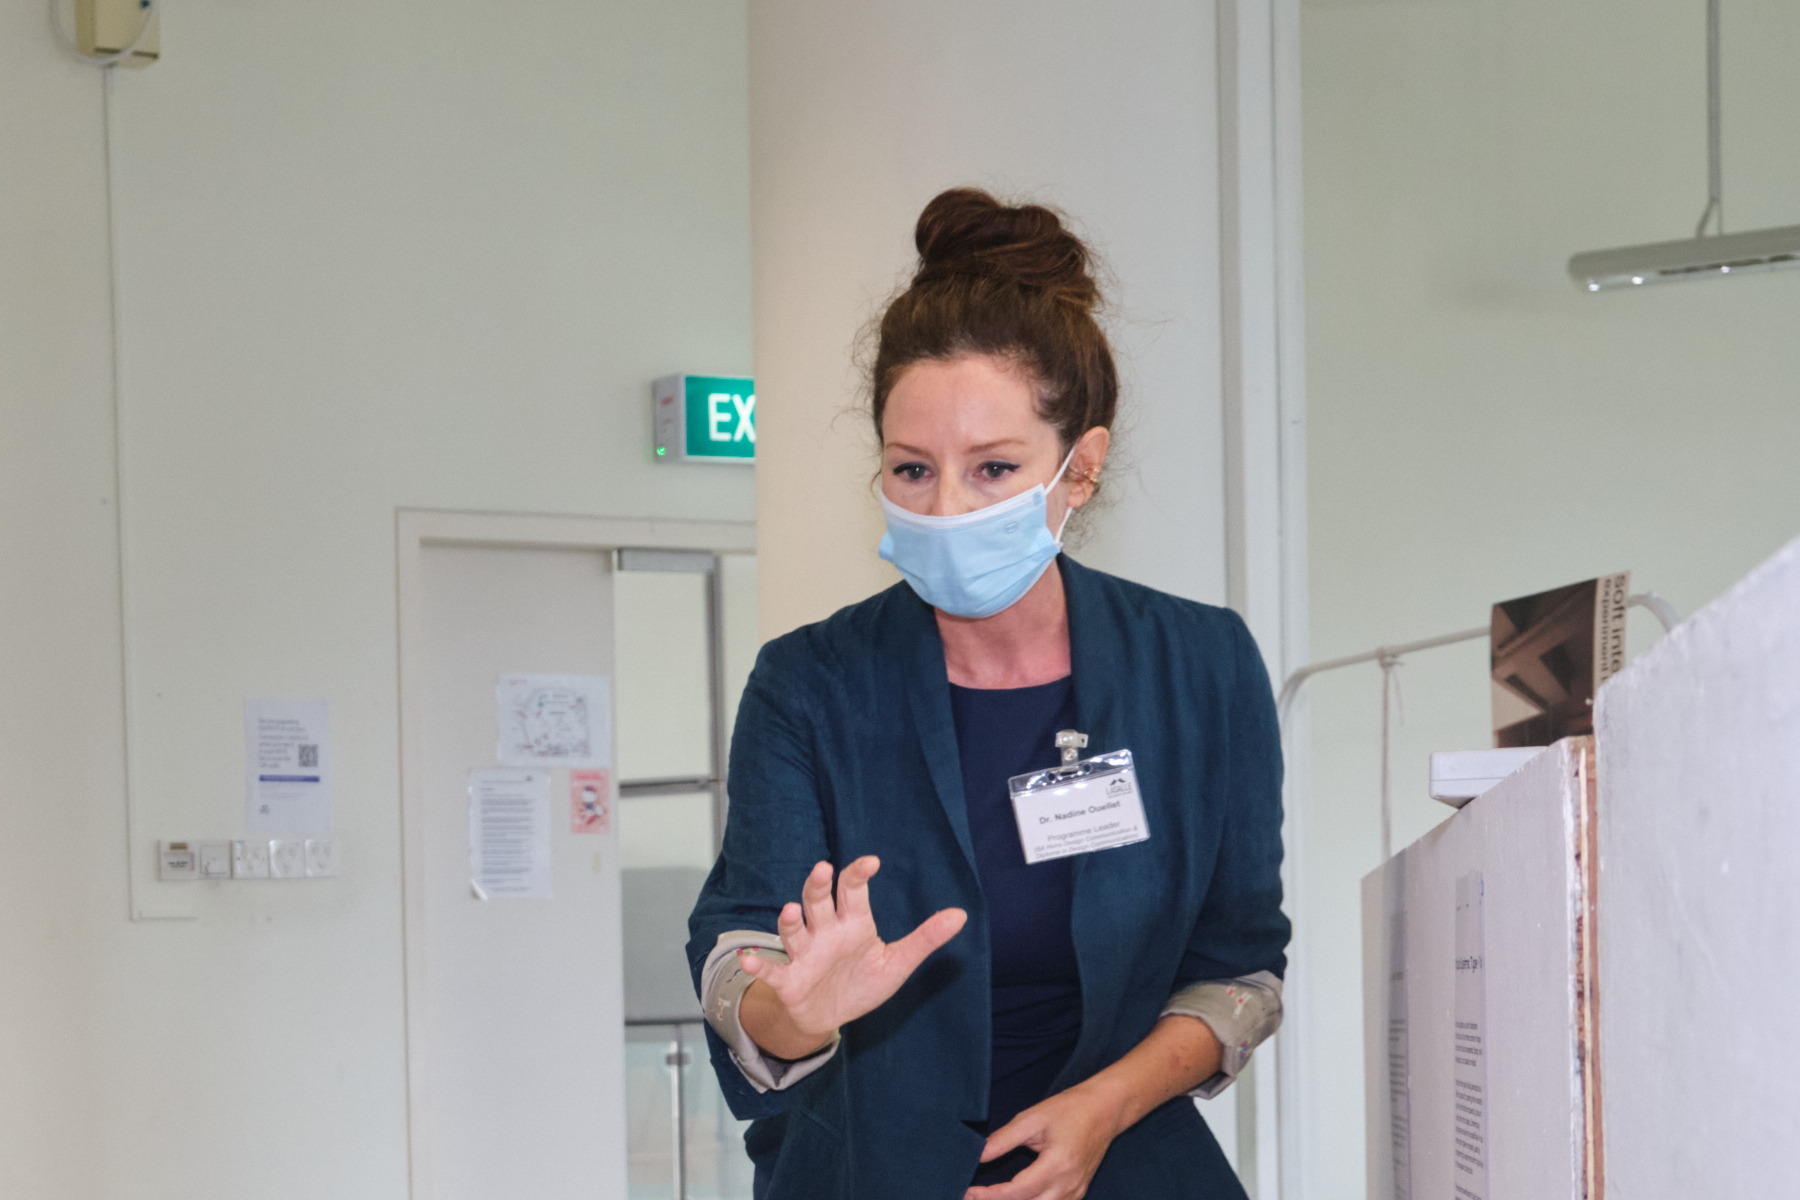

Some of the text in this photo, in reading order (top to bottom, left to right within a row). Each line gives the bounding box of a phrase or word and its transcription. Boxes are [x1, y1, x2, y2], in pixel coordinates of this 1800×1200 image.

[1055, 808, 1086, 821] Nadine
[1047, 821, 1120, 842] Programme Leader
